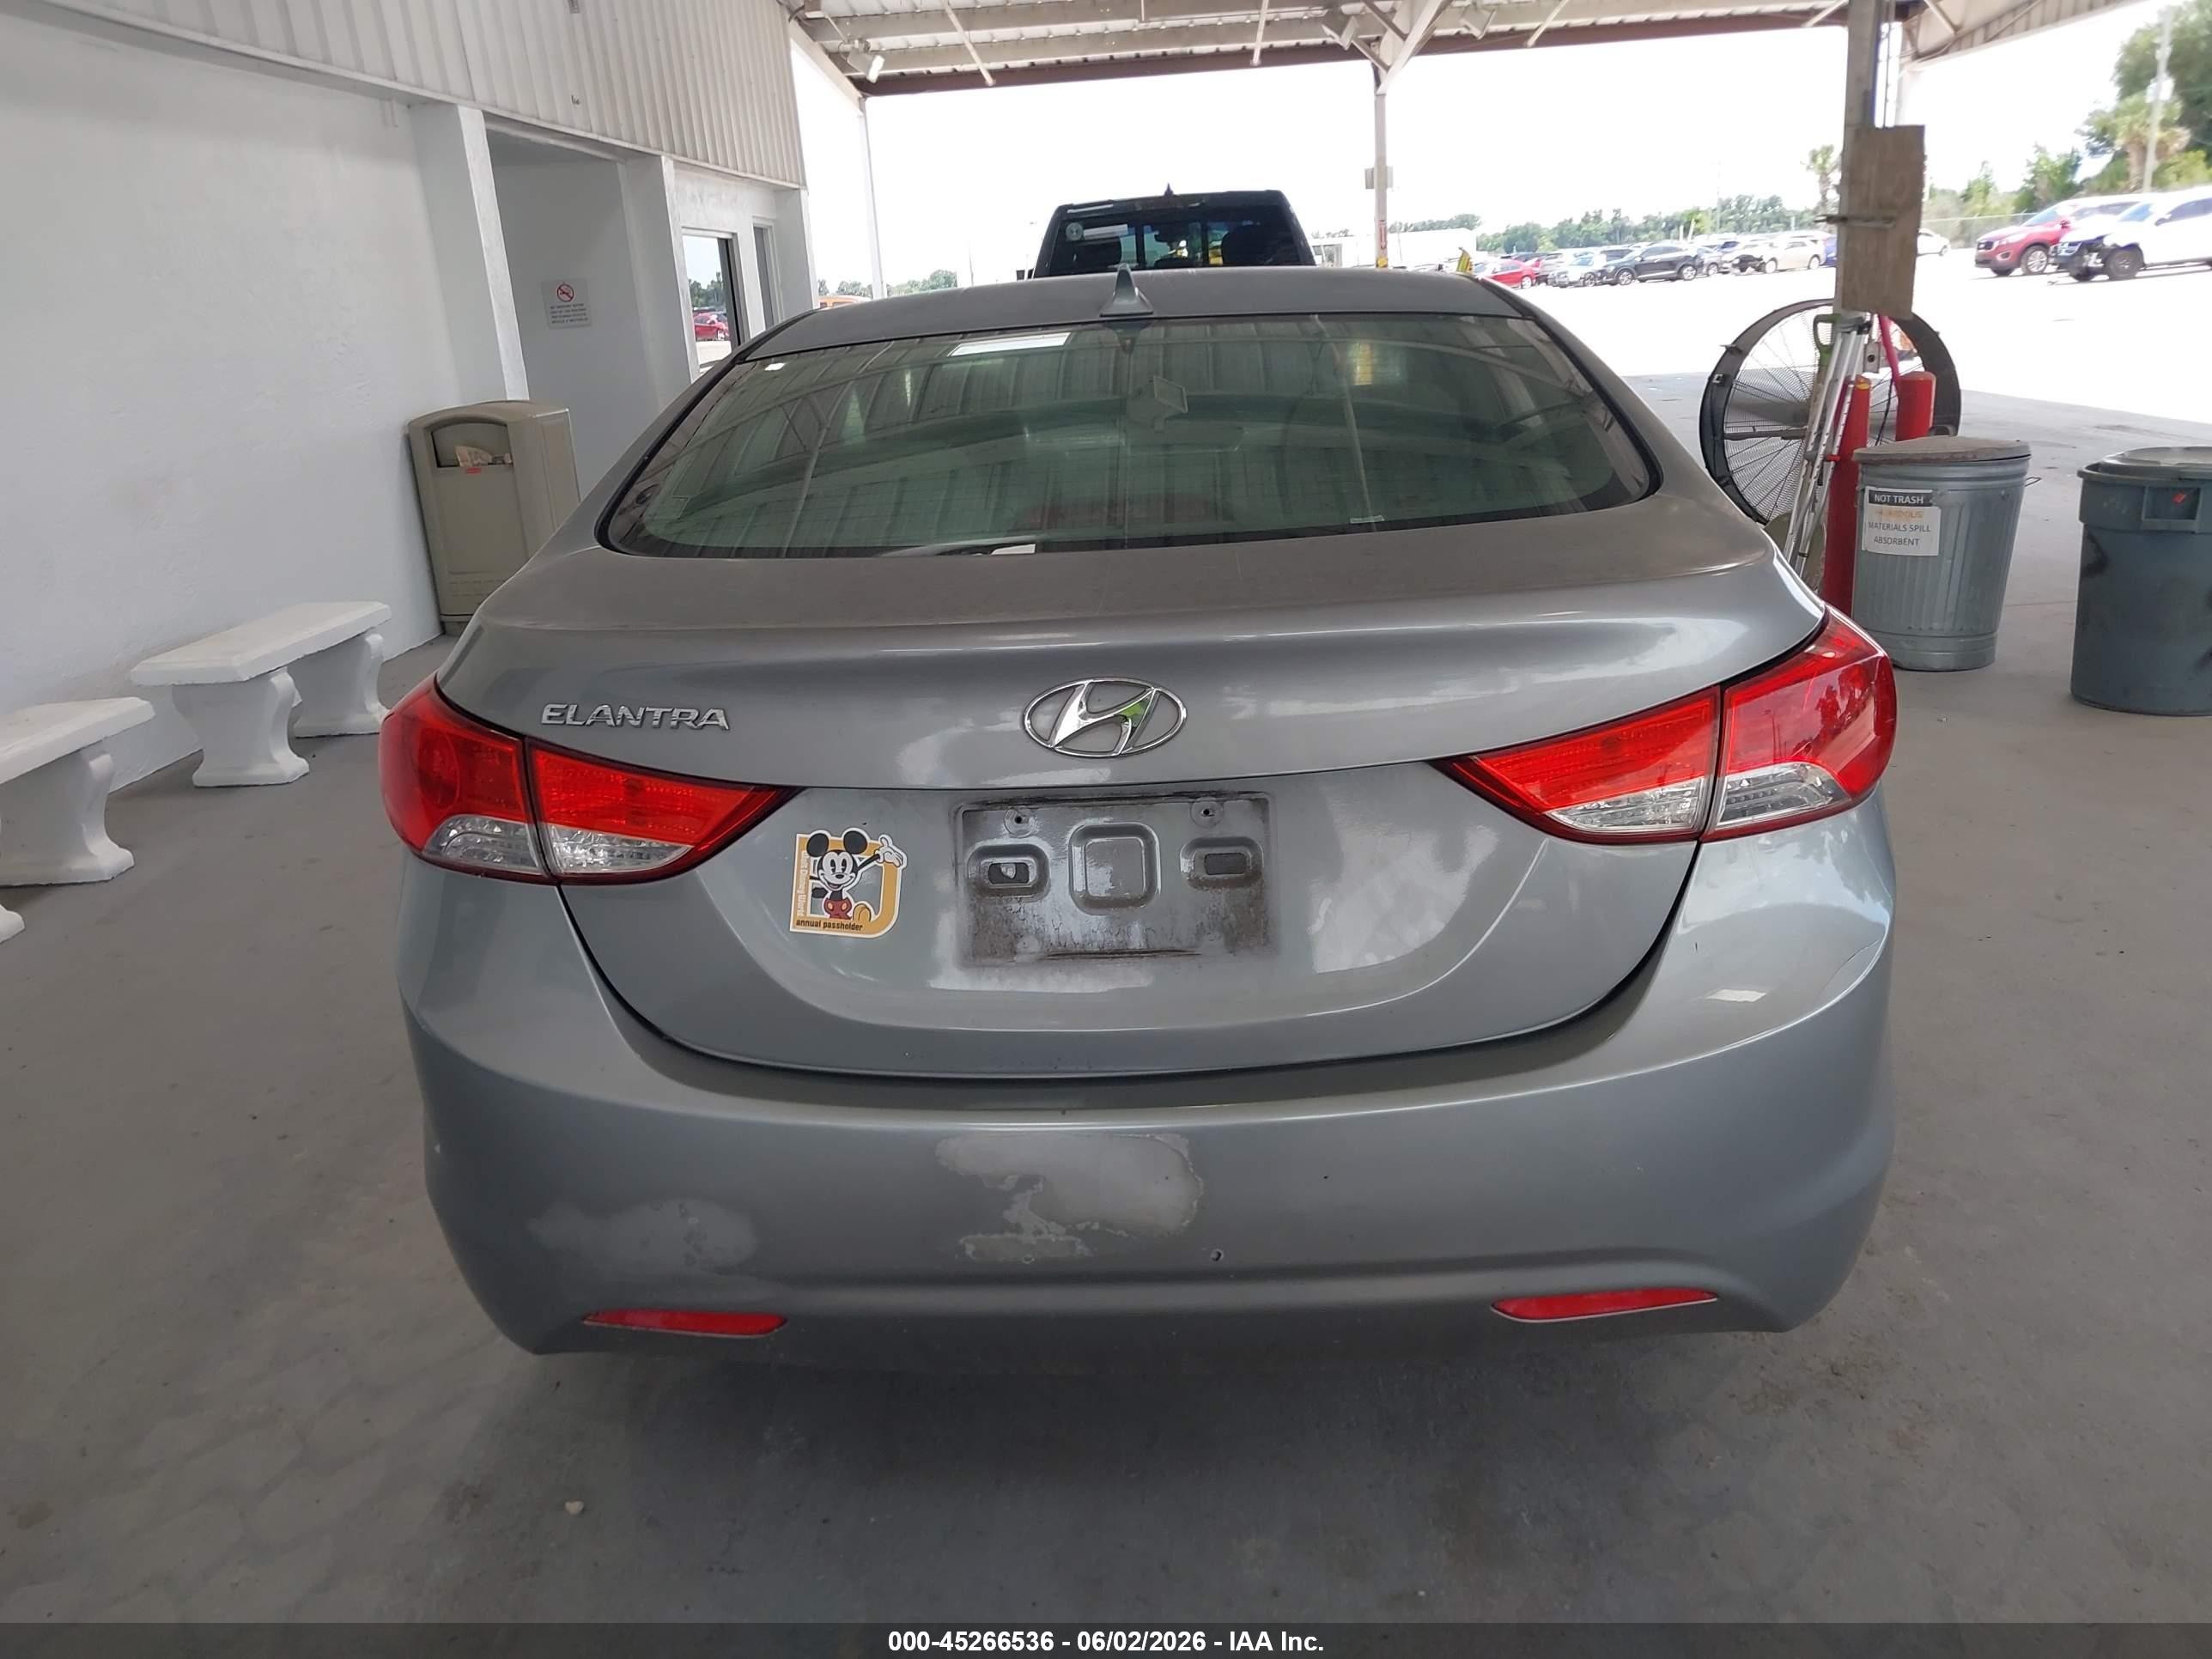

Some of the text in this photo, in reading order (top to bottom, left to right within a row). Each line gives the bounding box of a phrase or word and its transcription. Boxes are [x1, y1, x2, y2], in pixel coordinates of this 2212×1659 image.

[1875, 494, 1924, 504] NOT TRASH
[1869, 522, 1931, 532] MATERIALS SPILL
[1874, 536, 1920, 546] ABSORBENT
[541, 703, 730, 731] ELANTRA
[796, 919, 863, 932] annual passholder
